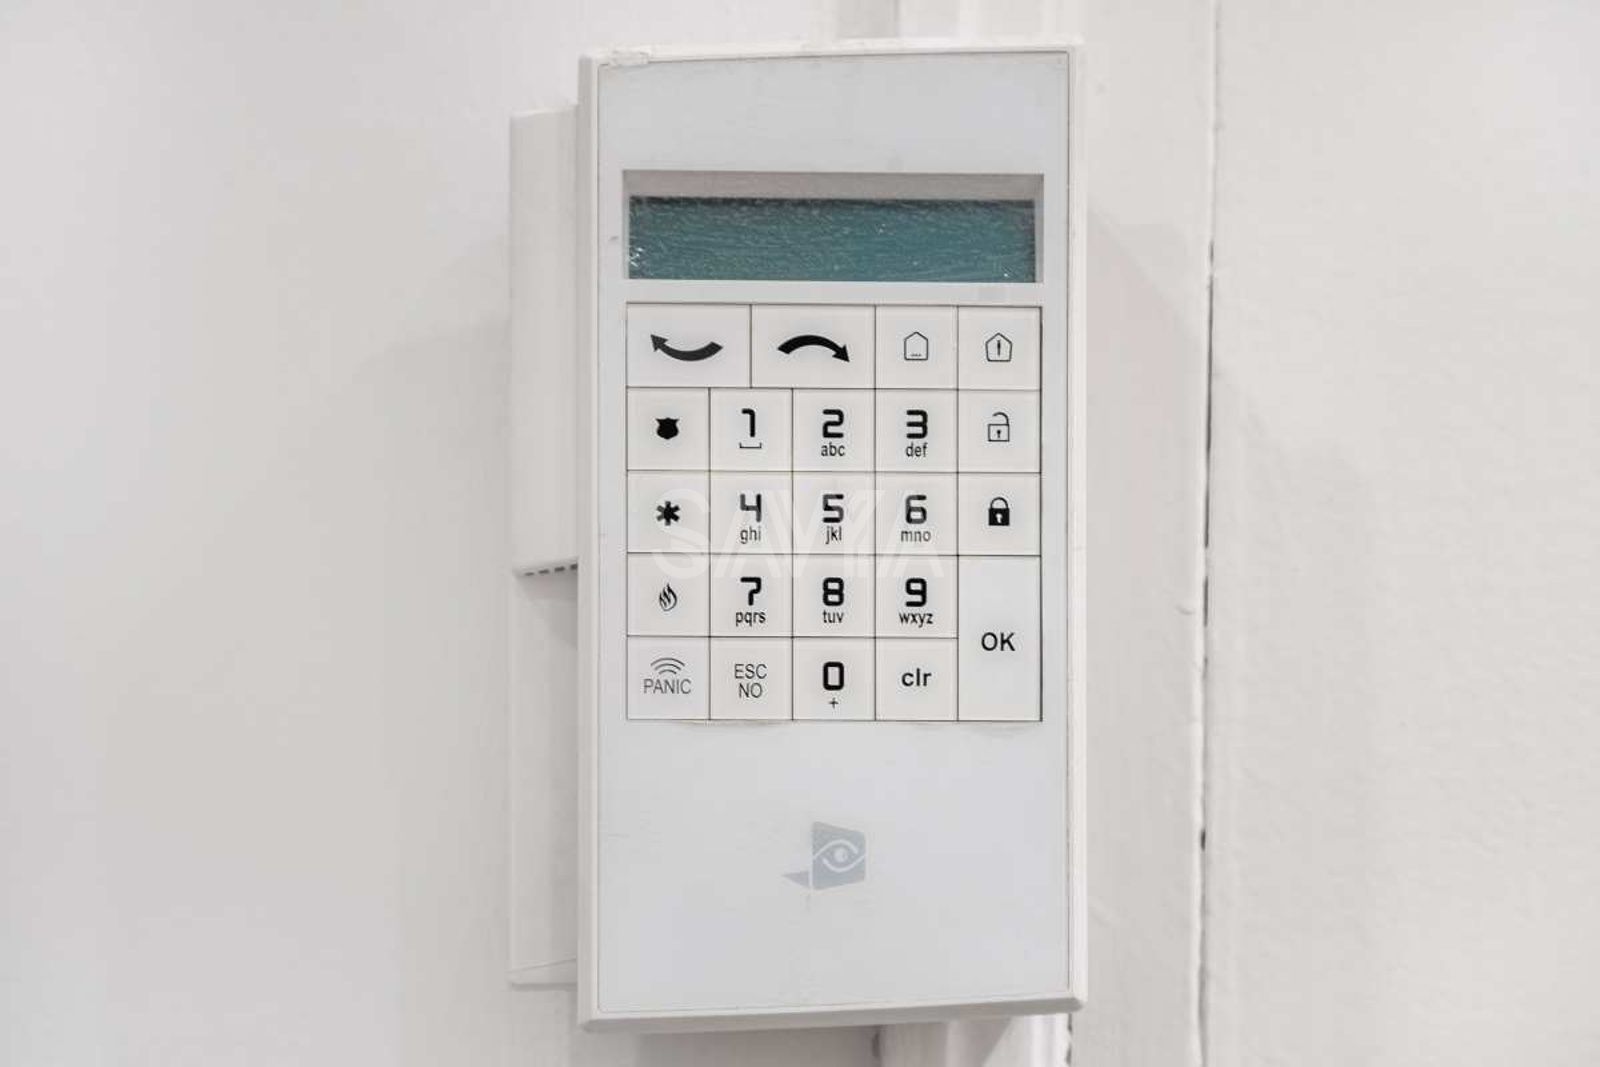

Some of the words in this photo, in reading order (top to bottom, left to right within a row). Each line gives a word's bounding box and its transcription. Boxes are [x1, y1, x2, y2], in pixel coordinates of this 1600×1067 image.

[741, 407, 756, 438] 1
[821, 408, 845, 439] 2
[905, 409, 929, 440] 3
[820, 441, 846, 458] abc
[905, 441, 929, 458] def
[739, 493, 762, 523] 4
[821, 493, 845, 524] 5
[905, 494, 928, 525] 6
[739, 526, 762, 545] ghi
[825, 525, 842, 545] jkl
[900, 530, 932, 543] mno
[739, 576, 763, 607] 7
[822, 576, 845, 607] 8
[904, 577, 928, 608] 9
[735, 611, 767, 627] pqrs
[822, 609, 844, 624] tuv
[898, 612, 934, 629] wxyz
[980, 632, 1016, 652] OK
[734, 663, 768, 680] ESC
[822, 660, 845, 692] 0
[901, 667, 932, 687] clr
[643, 678, 692, 695] PANIC
[738, 682, 763, 699] NO
